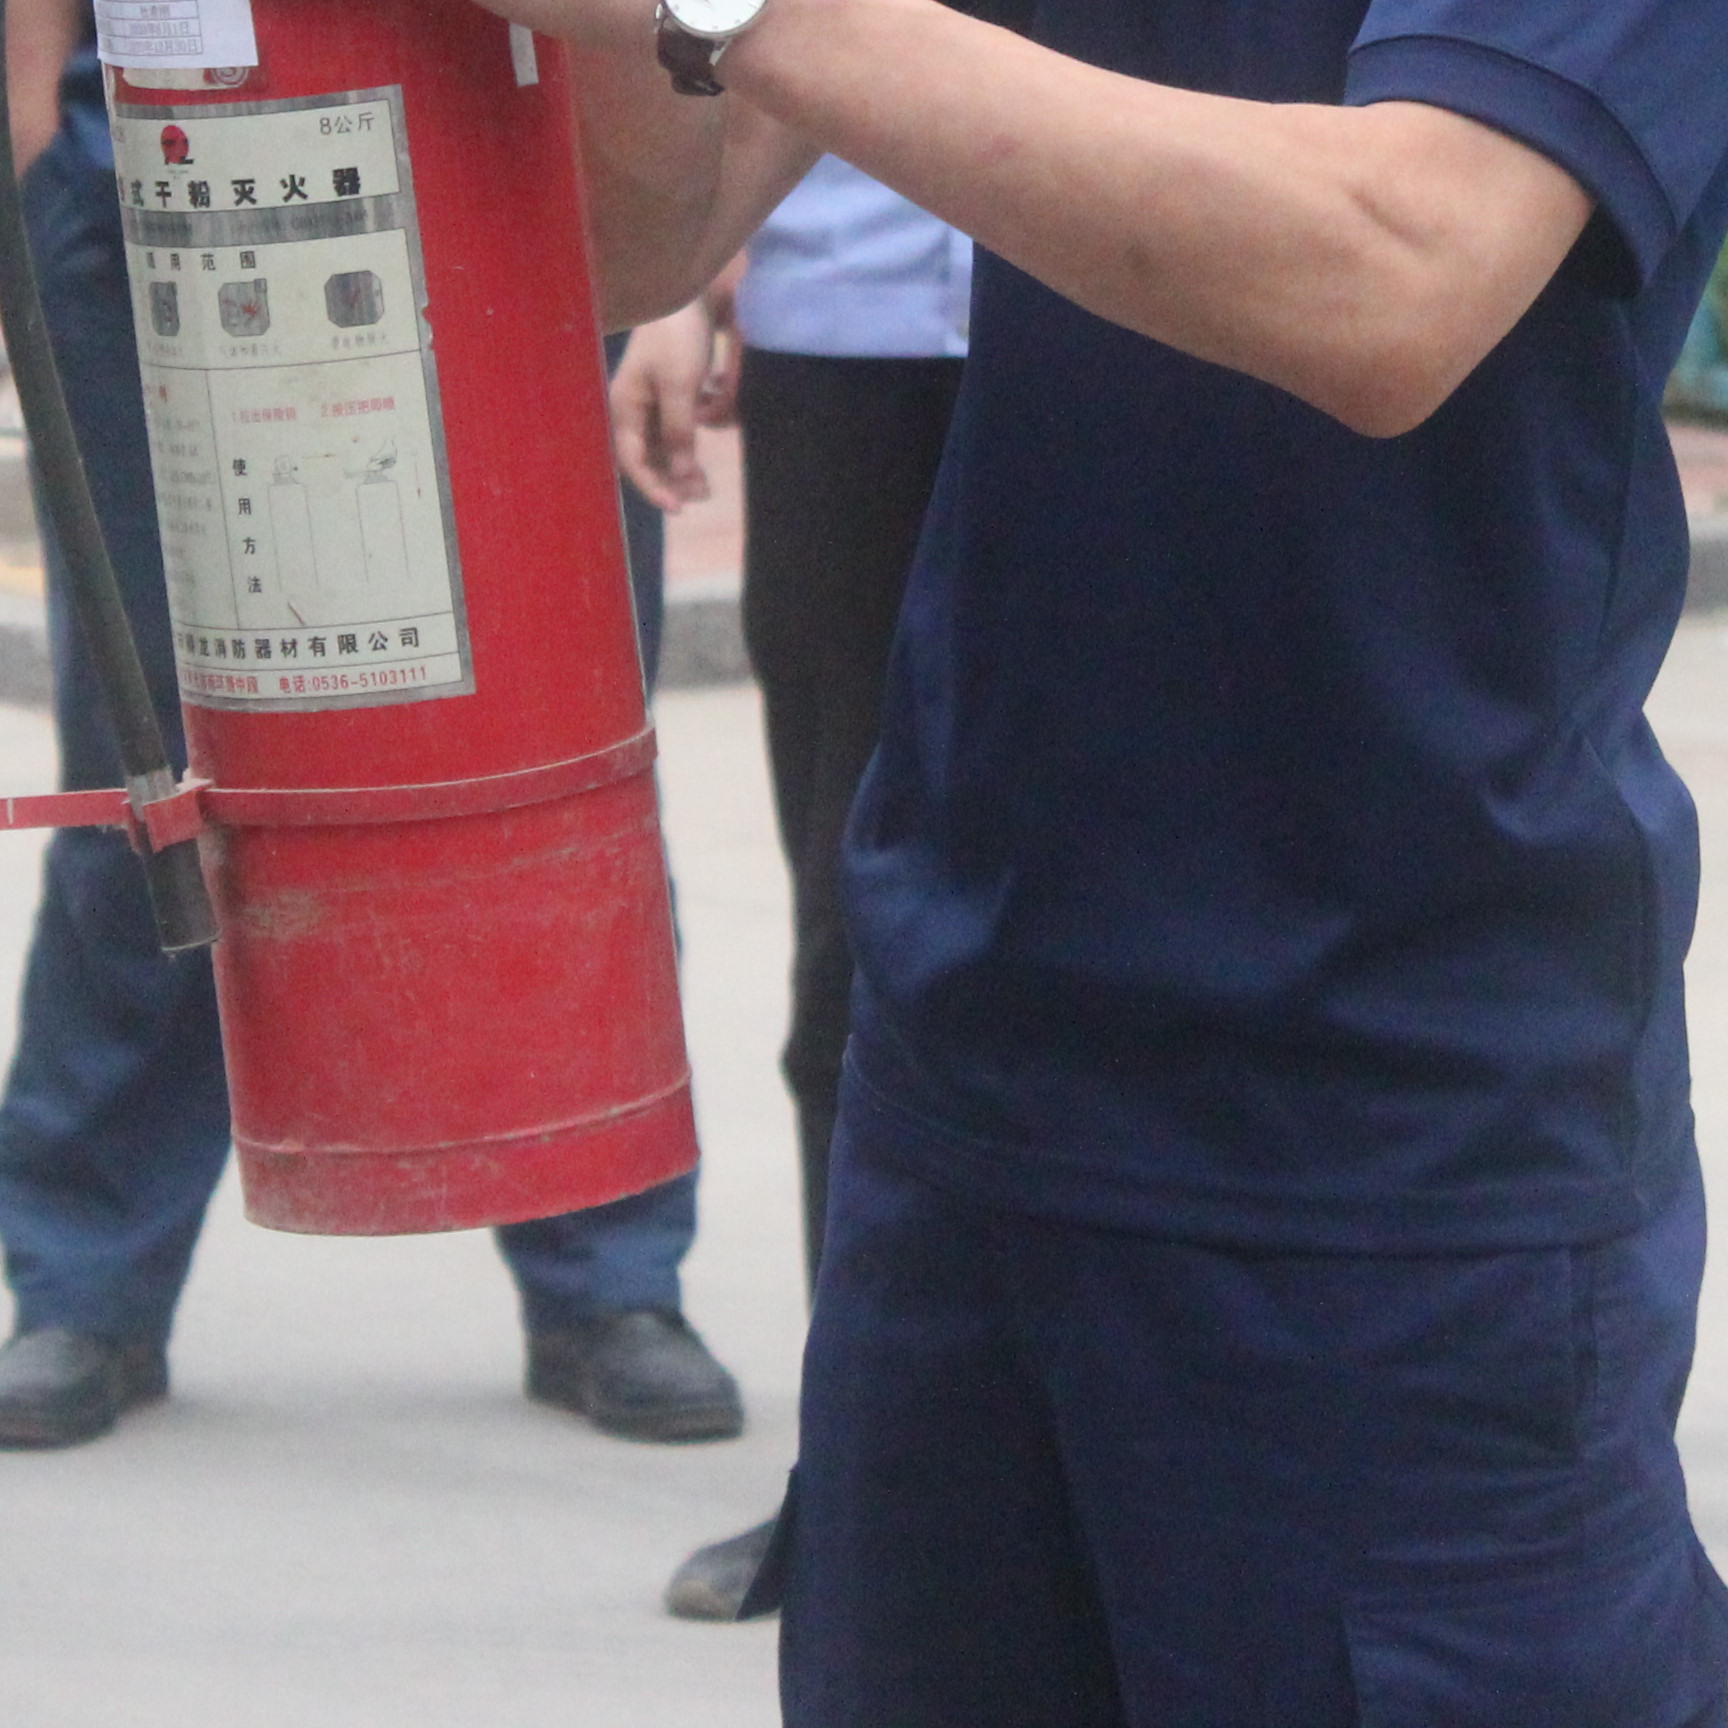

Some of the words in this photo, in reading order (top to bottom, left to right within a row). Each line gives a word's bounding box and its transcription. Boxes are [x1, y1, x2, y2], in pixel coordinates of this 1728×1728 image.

[320, 111, 376, 135] 8公斤
[232, 457, 263, 594] 使用方法
[279, 665, 427, 694] 电话:0536-5103111
